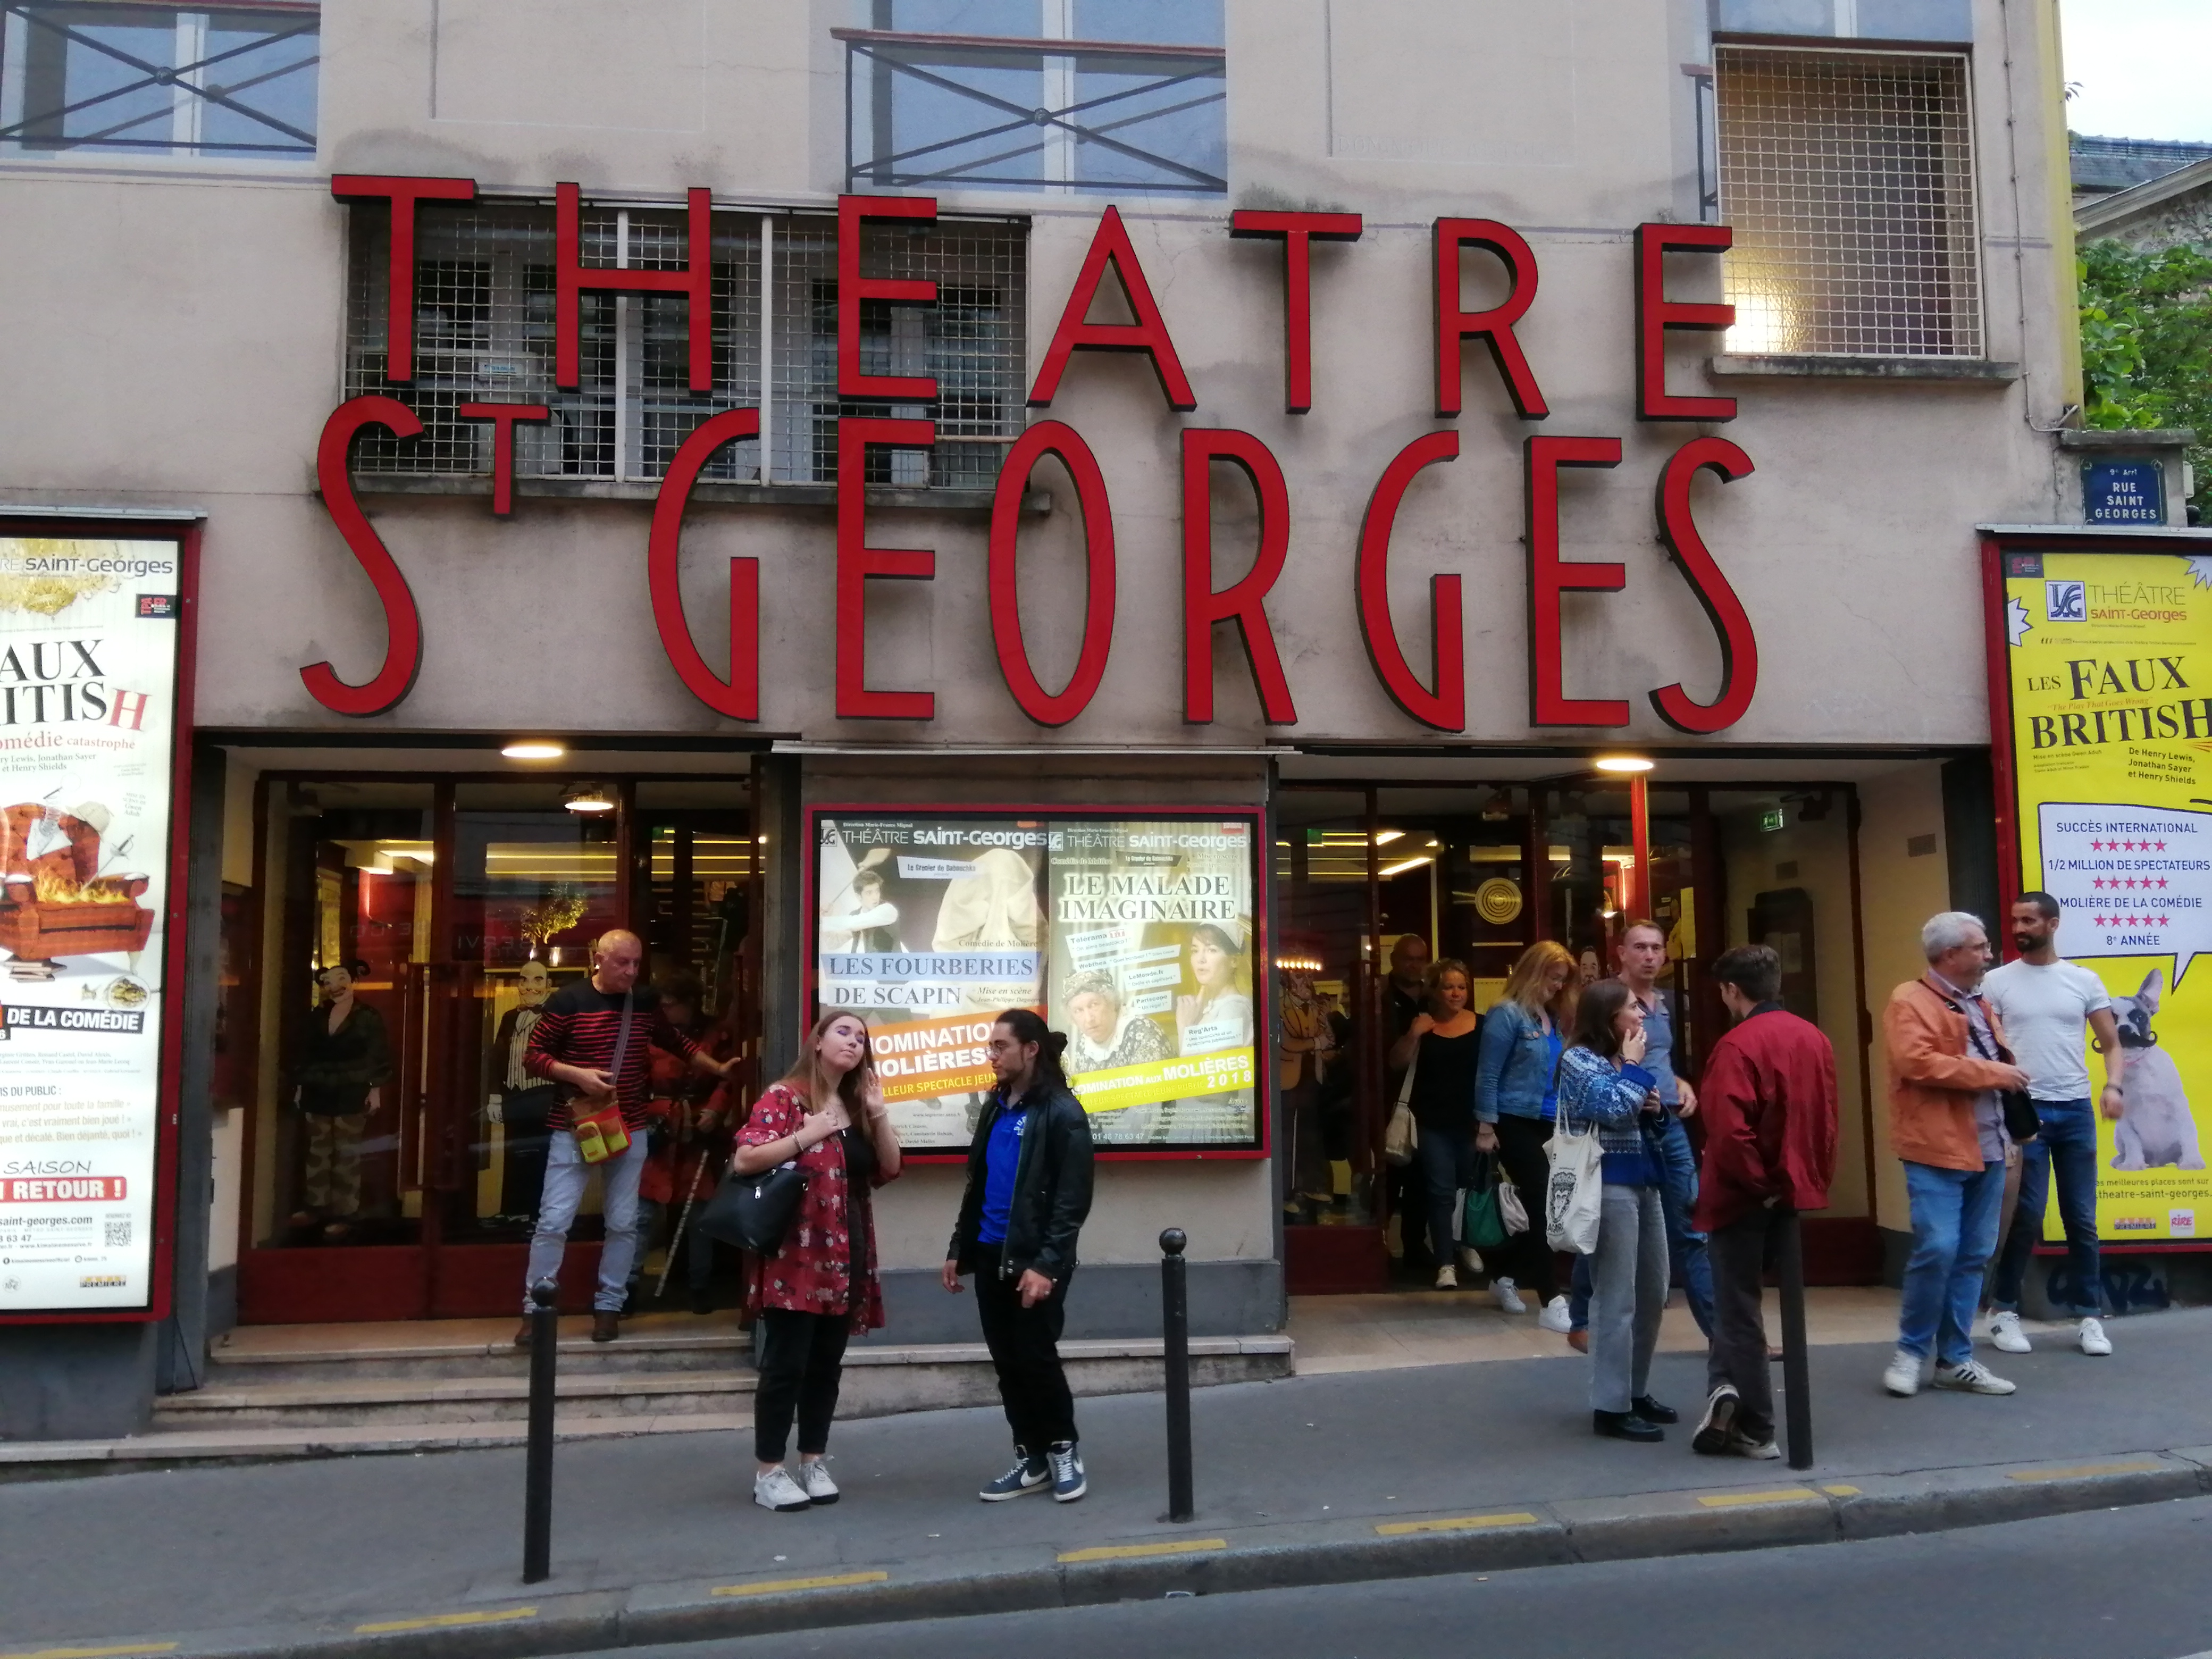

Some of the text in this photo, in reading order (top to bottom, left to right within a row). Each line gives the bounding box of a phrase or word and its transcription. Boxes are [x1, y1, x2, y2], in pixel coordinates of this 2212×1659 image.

[332, 174, 1737, 422] THEATRE
[2113, 482, 2136, 492] RUE
[2106, 495, 2143, 506] SAINT
[2094, 508, 2157, 519] GEORGES
[648, 407, 1758, 734] GEORGES
[2089, 582, 2186, 605] THÉÂTRE
[0, 639, 106, 682] AUX
[2027, 656, 2190, 700] LES FAUX
[2028, 698, 2212, 749] BRITISH
[0, 731, 135, 750] médie catastrophe
[11, 755, 36, 763] Lewis,
[37, 753, 73, 762] Jonathan
[76, 752, 96, 761] Sayer
[2142, 749, 2166, 760] Henry
[2168, 752, 2195, 764] Lewis,
[12, 764, 37, 773] Henry
[2129, 759, 2191, 774] Jonathan Sayer
[2139, 772, 2164, 782] Henry
[2165, 774, 2196, 785] Shields
[2057, 820, 2198, 833] SUCCÈS INTERNATIONAL
[842, 828, 909, 844] THÉÂTRE
[1067, 833, 1125, 848] THÉÂTRE
[1051, 857, 1079, 865] Comédie
[2049, 859, 2210, 870] 1/2 MILLION DE SPECTATEURS
[1067, 876, 1230, 895] LE MALADE
[2060, 895, 2202, 908] MOLIÈRE DE LA COMÉDIE
[1062, 900, 1236, 920] IMAGINAIRE
[1070, 933, 1107, 944] Télérama
[2121, 933, 2160, 945] ANNÉE
[830, 958, 1033, 975] LES FOURBERIES
[1129, 970, 1163, 980] LeMonde.fr
[834, 987, 960, 1004] DE SCAPIN
[1136, 995, 1168, 1004] Pariscope
[7, 1008, 139, 1030] DE LA COMÉDIE
[870, 1021, 994, 1055] OMINATIO
[1188, 1026, 1218, 1035] Reg'Arts
[1145, 1075, 1162, 1084] AUX
[1163, 1055, 1250, 1081] MOLIÈRES
[11, 1085, 56, 1096] DU PUBLIC
[917, 1075, 972, 1092] SPECTACLE
[1111, 1079, 1204, 1101] SPECTACLE JEUNE PUBLIC
[43, 1102, 61, 1112] pour
[64, 1101, 85, 1110] toute
[87, 1100, 94, 1109] la
[97, 1099, 124, 1109] famille
[44, 1116, 80, 1126] vraiment
[82, 1116, 100, 1125] bien
[101, 1115, 119, 1126] joué
[15, 1133, 22, 1143] et
[56, 1130, 75, 1141] Bien
[112, 1128, 130, 1141] quoi
[4, 1161, 91, 1175] SAISON
[13, 1180, 105, 1200] RETOUR
[2151, 1179, 2175, 1187] places
